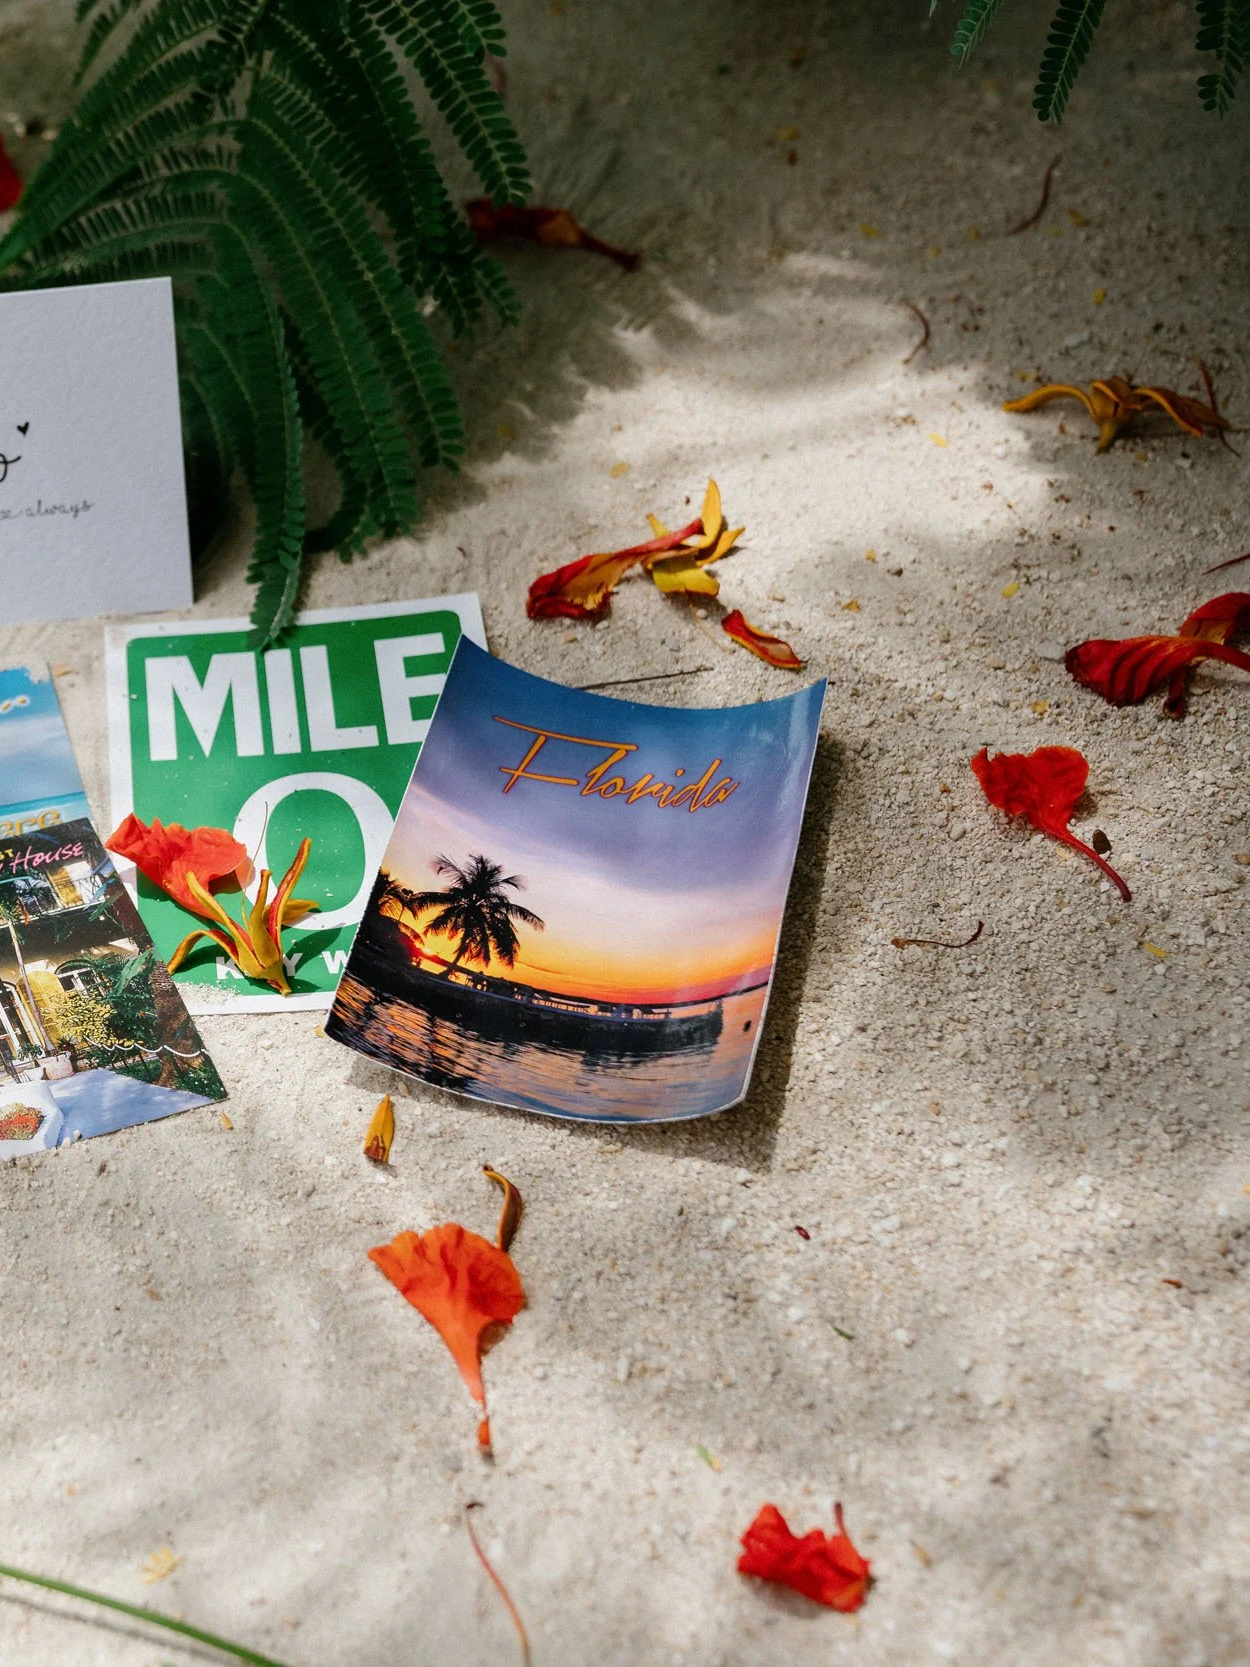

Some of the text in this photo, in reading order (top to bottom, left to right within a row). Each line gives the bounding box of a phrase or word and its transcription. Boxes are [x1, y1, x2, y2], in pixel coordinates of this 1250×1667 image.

[25, 499, 95, 520] always
[144, 631, 449, 762] MILE
[492, 715, 741, 813] Florida
[215, 952, 304, 981] KY
